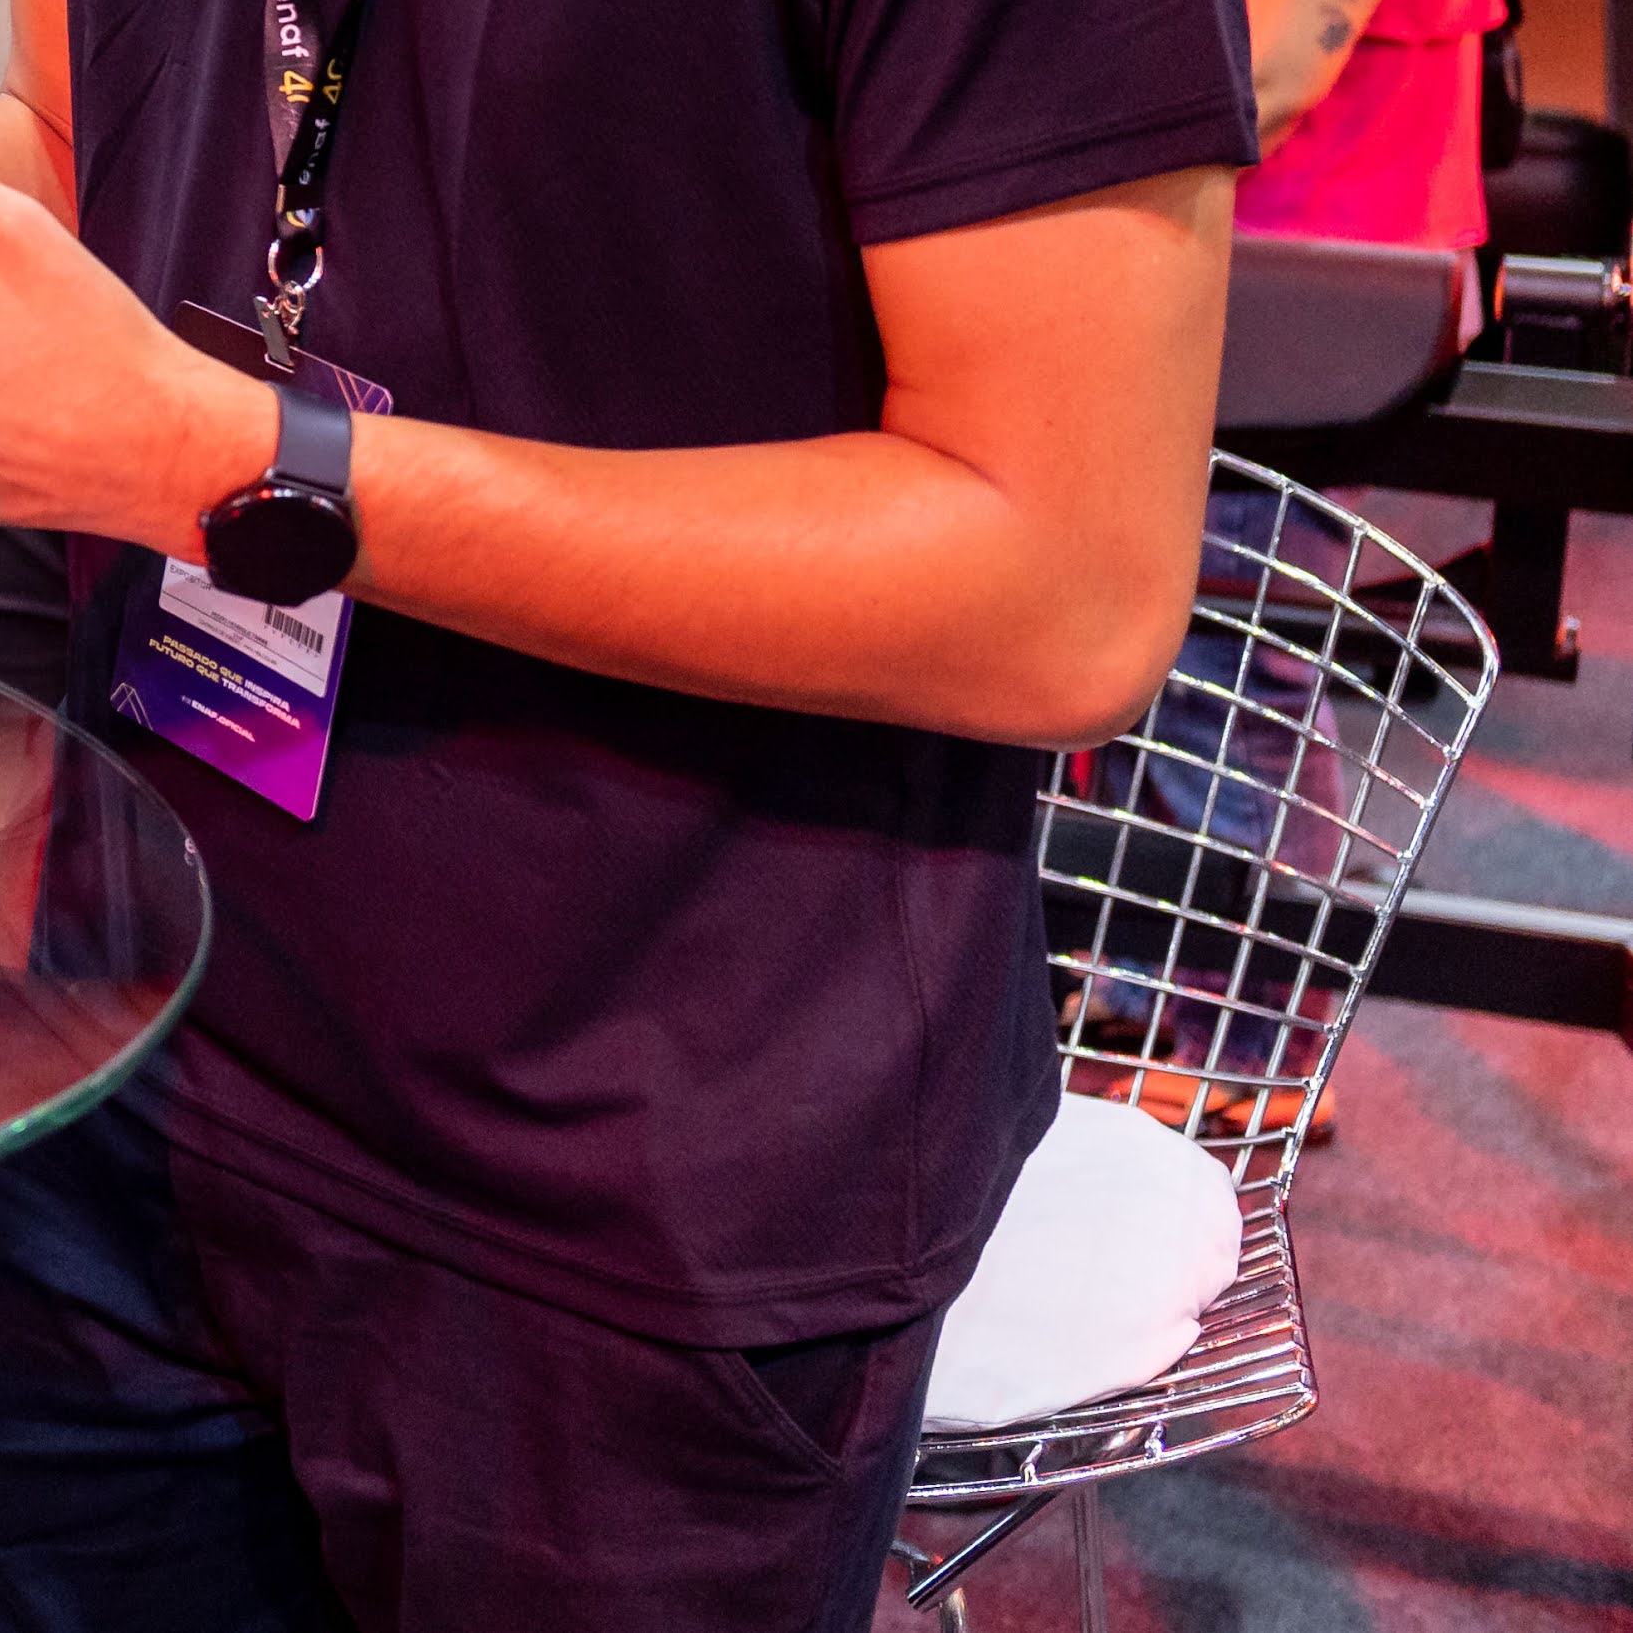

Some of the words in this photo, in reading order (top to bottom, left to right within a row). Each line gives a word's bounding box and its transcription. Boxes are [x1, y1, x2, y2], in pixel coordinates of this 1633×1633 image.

[148, 638, 195, 669] FUTURO
[195, 664, 221, 684] QUE
[221, 677, 301, 730] TRANSFORMA
[162, 634, 218, 670] PASSADO
[219, 662, 245, 684] QUE
[244, 679, 291, 712] INSPIRA
